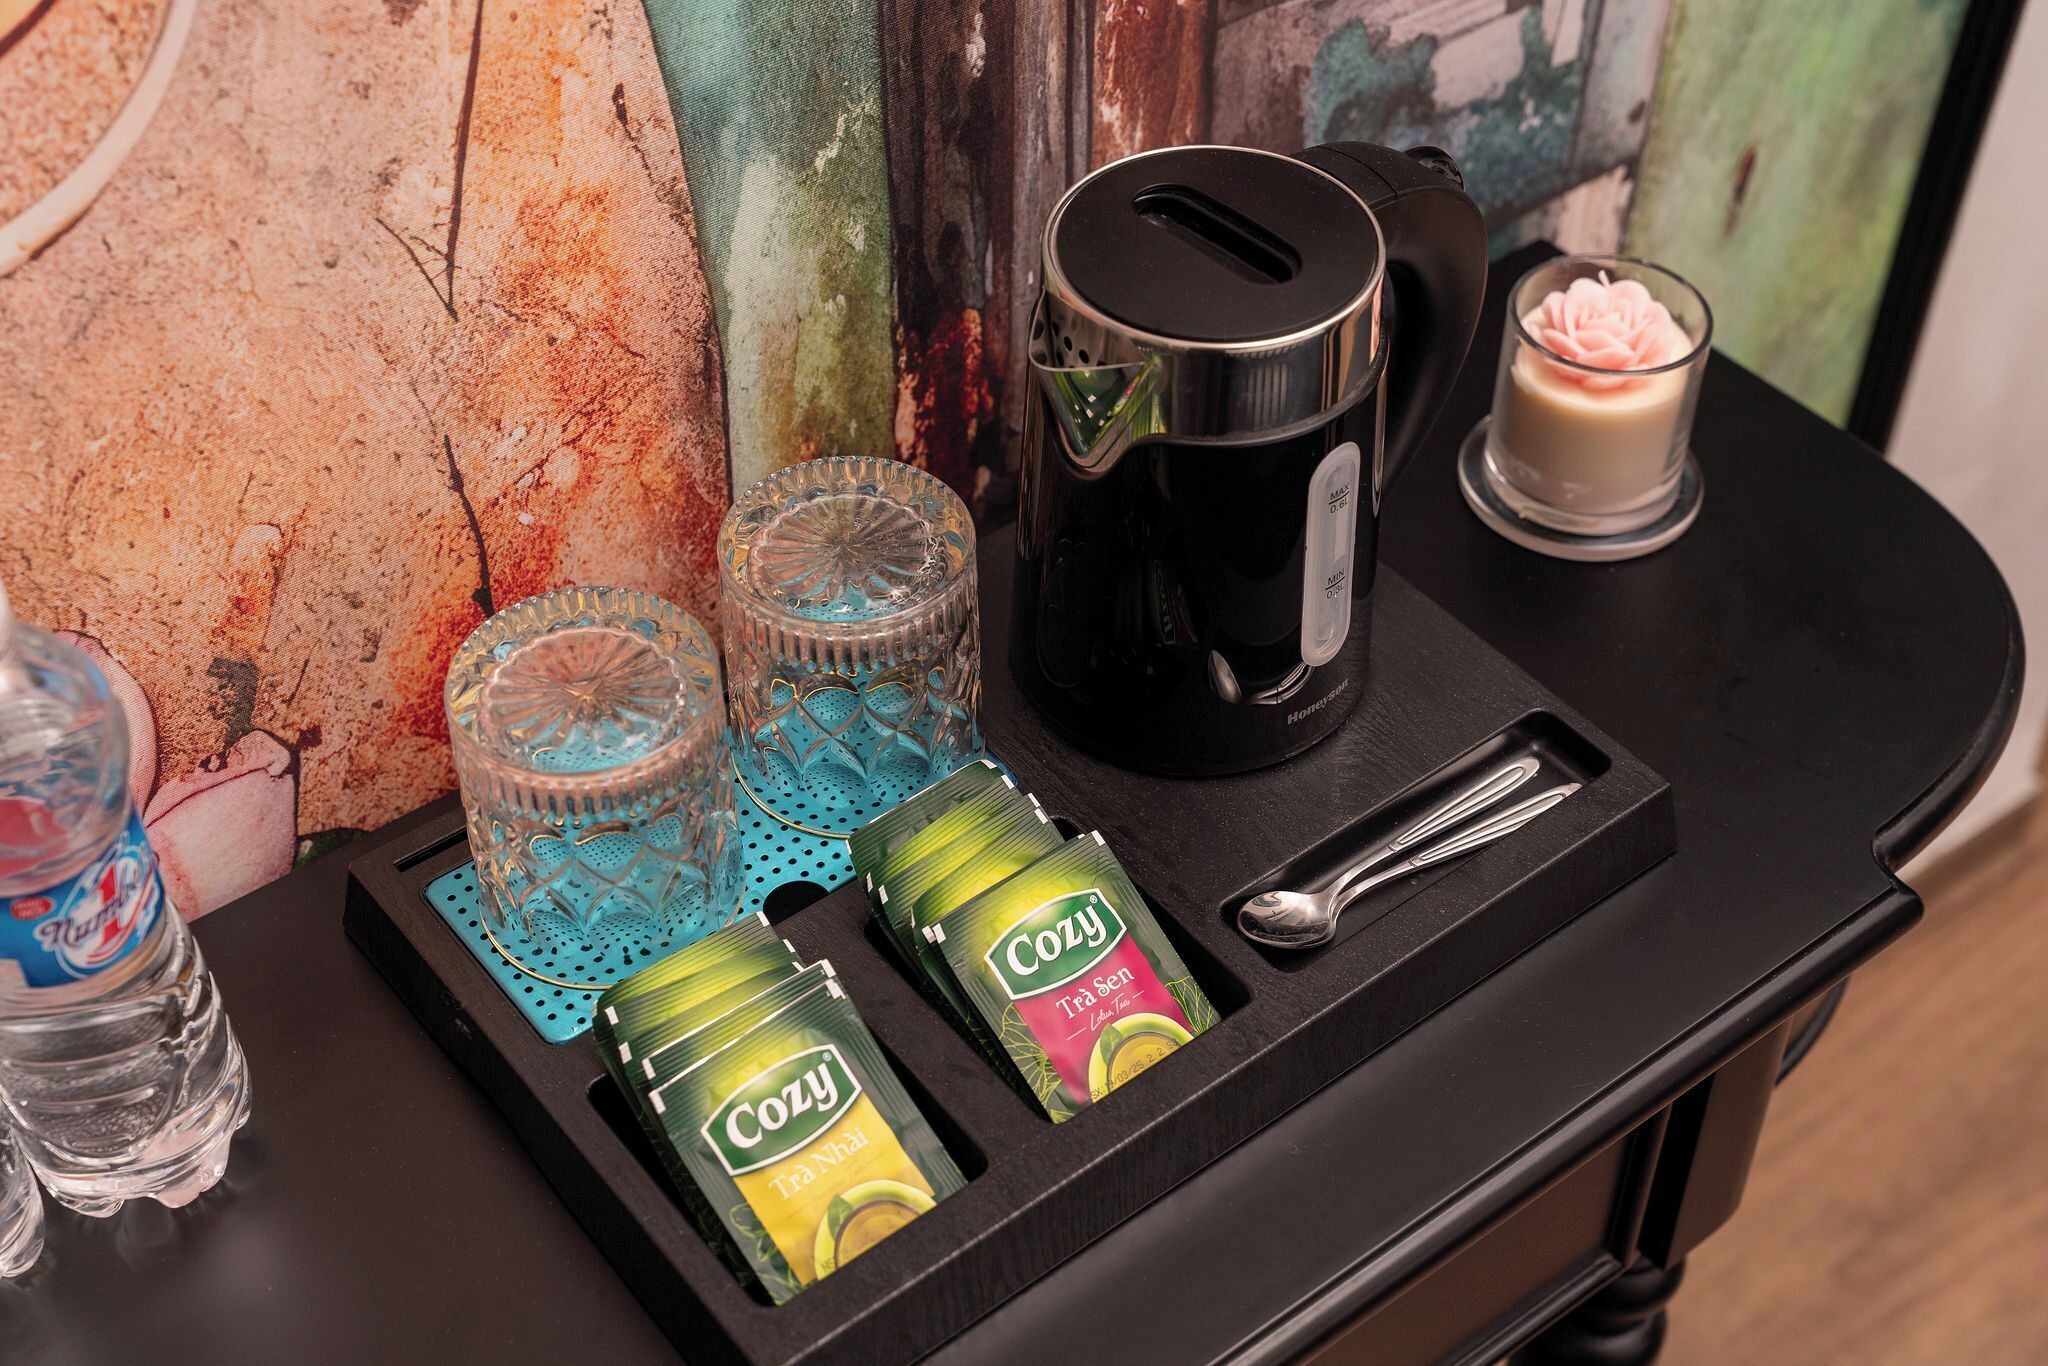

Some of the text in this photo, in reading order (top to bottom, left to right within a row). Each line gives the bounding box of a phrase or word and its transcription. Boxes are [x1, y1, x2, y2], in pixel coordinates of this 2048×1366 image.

[1329, 483, 1350, 501] MAX
[1329, 497, 1349, 514] 0.6L
[1326, 583, 1344, 599] 0.3L
[1327, 568, 1345, 586] MIN
[1287, 678, 1349, 725] Honeyson
[1006, 905, 1108, 976] Cozy
[1056, 966, 1135, 1020] Trà Sen
[1111, 992, 1131, 1014] Tea
[726, 1062, 840, 1149] Cozy
[768, 1164, 817, 1200] Trà
[810, 1126, 870, 1175] Nhài
